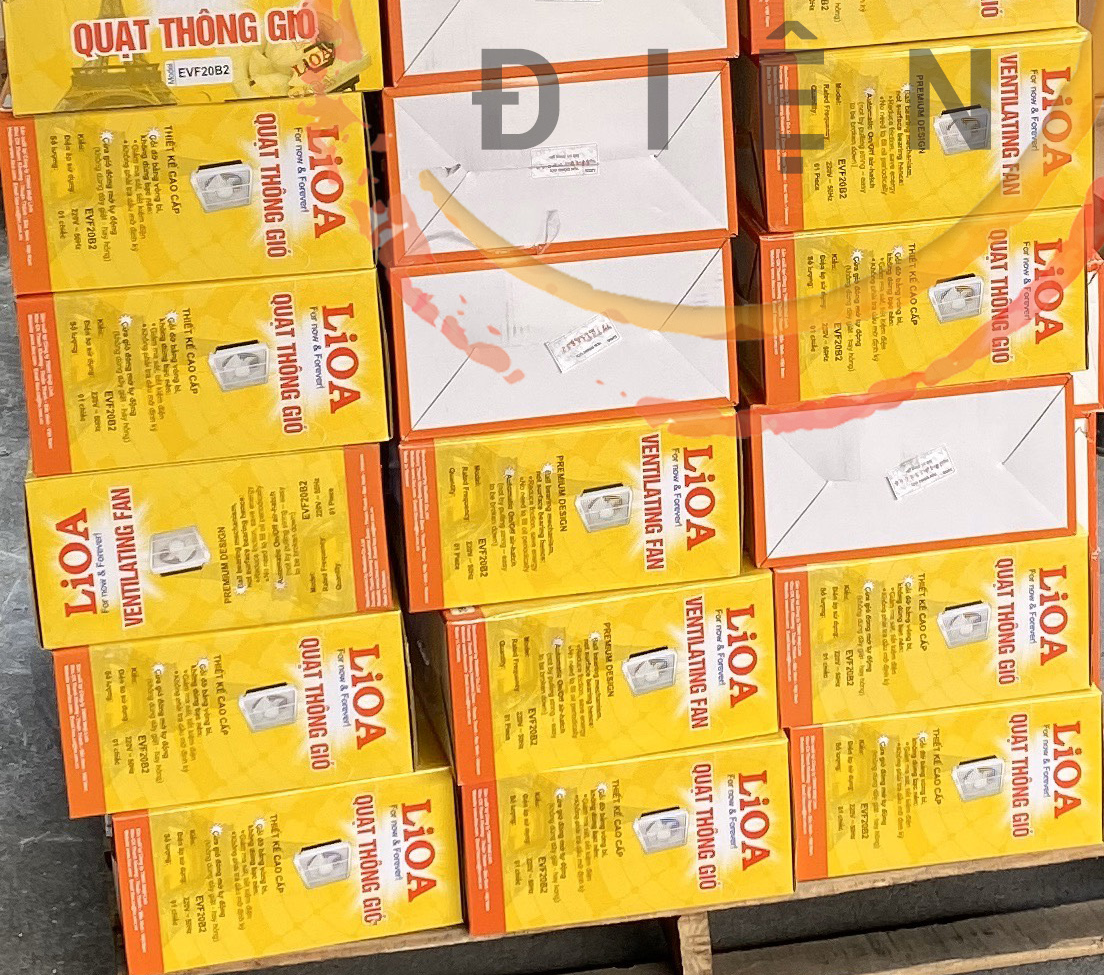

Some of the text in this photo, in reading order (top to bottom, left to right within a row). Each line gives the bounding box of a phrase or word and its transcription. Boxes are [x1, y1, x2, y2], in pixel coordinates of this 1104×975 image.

[73, 1, 317, 59] QUẠT THÔNG GIÓ
[178, 65, 231, 79] EVF20B2
[295, 127, 303, 141] For
[297, 143, 305, 163] now
[916, 75, 927, 154] PREMIUM DESIGN
[1000, 54, 1020, 196] VENTILATING FAN
[1041, 67, 1073, 176] LiOA
[84, 207, 97, 250] EVF20B2
[169, 171, 179, 192] CAO
[253, 113, 292, 259] QUẠT THÔNG GIÓ
[306, 125, 346, 239] LiOA
[838, 159, 847, 199] EVF20B2
[985, 229, 1014, 364] QUẠT THÔNG GIÓ
[1033, 238, 1064, 345] LiOA
[270, 293, 306, 435] QUẠT THÔNG GIÓ
[322, 303, 361, 414] LiOA
[641, 434, 664, 570] VENTILATING FAN
[683, 445, 716, 551] LiOA
[55, 508, 98, 618] LiOA
[110, 487, 143, 628] VENTILATING FAN
[222, 563, 232, 604] PREMIUM
[685, 596, 708, 729] VENTILATING FAN
[726, 604, 759, 708] LiOA
[993, 558, 1021, 685] QUẠT THÔNG GIÓ
[1038, 565, 1068, 666] LiOA
[298, 637, 335, 771] QUẠT THÔNG GIÓ
[349, 644, 386, 750] LiOA
[738, 770, 770, 871] LiOA
[1008, 714, 1035, 838] QUẠT THÔNG GIÓ
[1052, 721, 1082, 819] LiOA
[351, 795, 386, 925] QUẠT THÔNG GIÓ
[401, 799, 437, 902] LiOA
[691, 764, 721, 890] QUẠT THÔNG GIÓ
